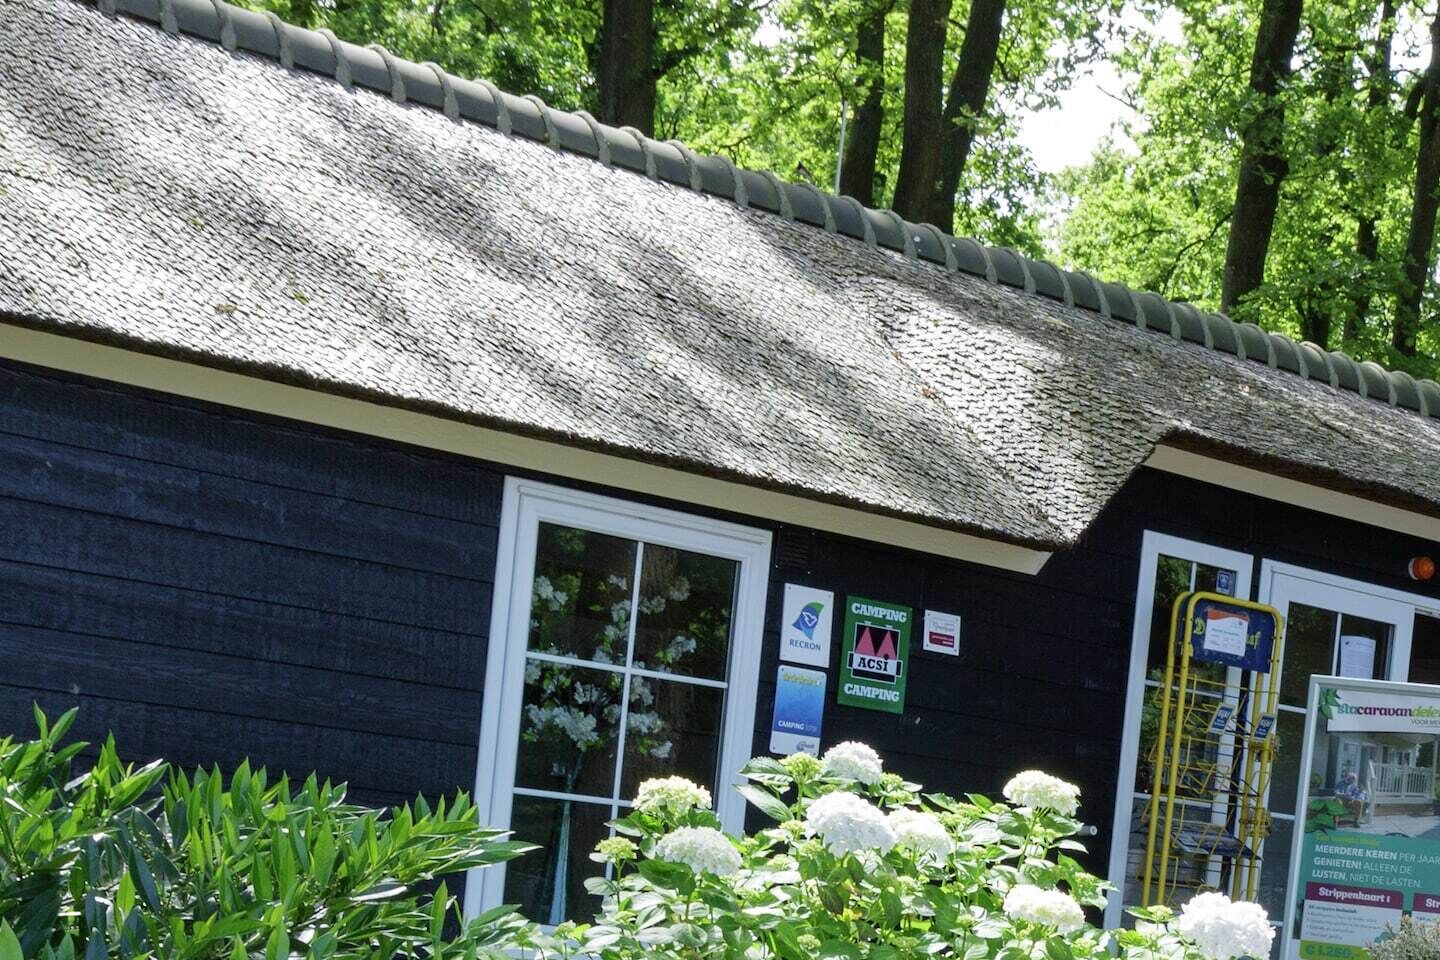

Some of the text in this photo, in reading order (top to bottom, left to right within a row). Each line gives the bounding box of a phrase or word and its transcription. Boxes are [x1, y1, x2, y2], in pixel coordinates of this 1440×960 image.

[851, 602, 907, 623] CAMPING
[789, 639, 821, 651] RECRON
[844, 683, 900, 702] CAMPING
[778, 720, 804, 730] CAMPING
[1315, 844, 1440, 865] MEERDERE KEREN PER JAAR
[1314, 857, 1412, 875] GENIETEN! ALLEEN DE
[1350, 873, 1370, 882] NIET
[1372, 875, 1384, 885] DE
[1319, 886, 1384, 902] Strippenkaart
